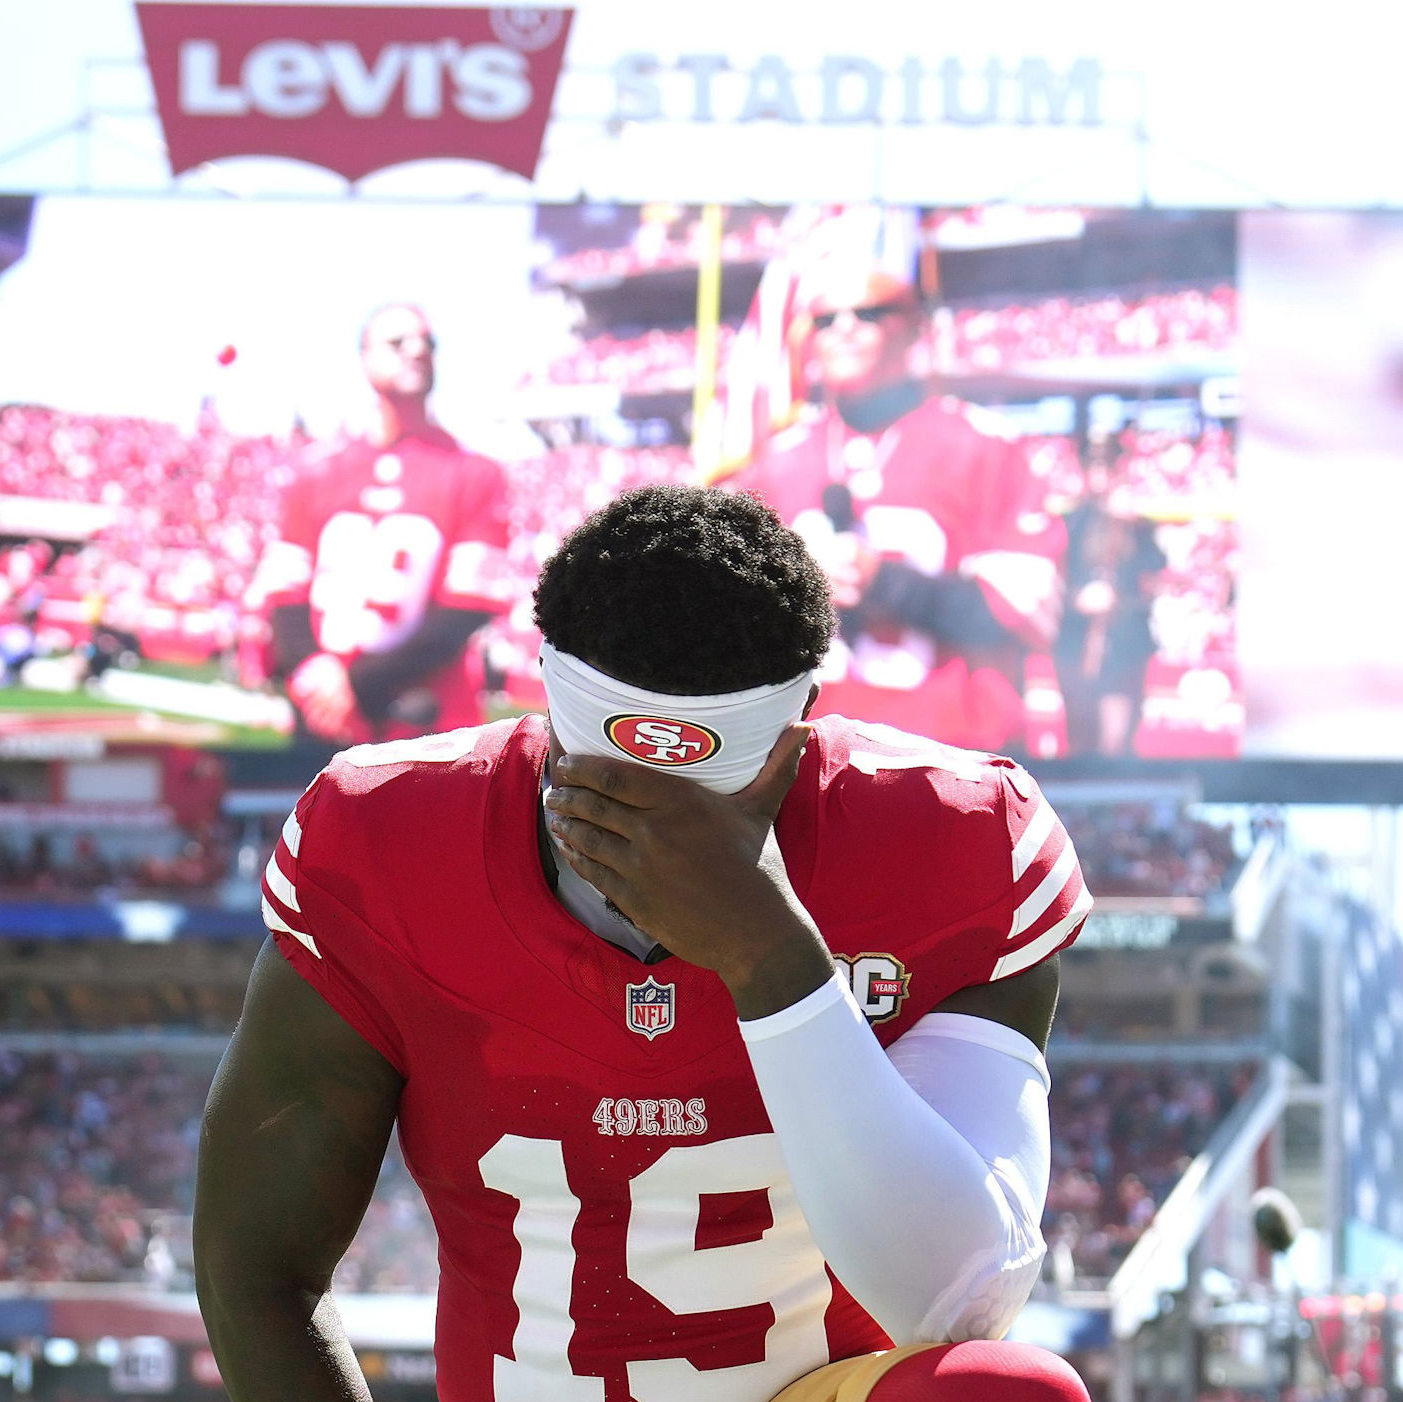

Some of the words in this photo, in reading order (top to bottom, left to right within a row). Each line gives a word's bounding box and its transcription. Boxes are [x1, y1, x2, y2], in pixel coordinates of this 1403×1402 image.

[612, 54, 1102, 127] STADIUM
[634, 721, 702, 762] SF
[874, 983, 898, 993] YEARS
[633, 1005, 668, 1029] NFL
[592, 1097, 708, 1136] 49ERS
